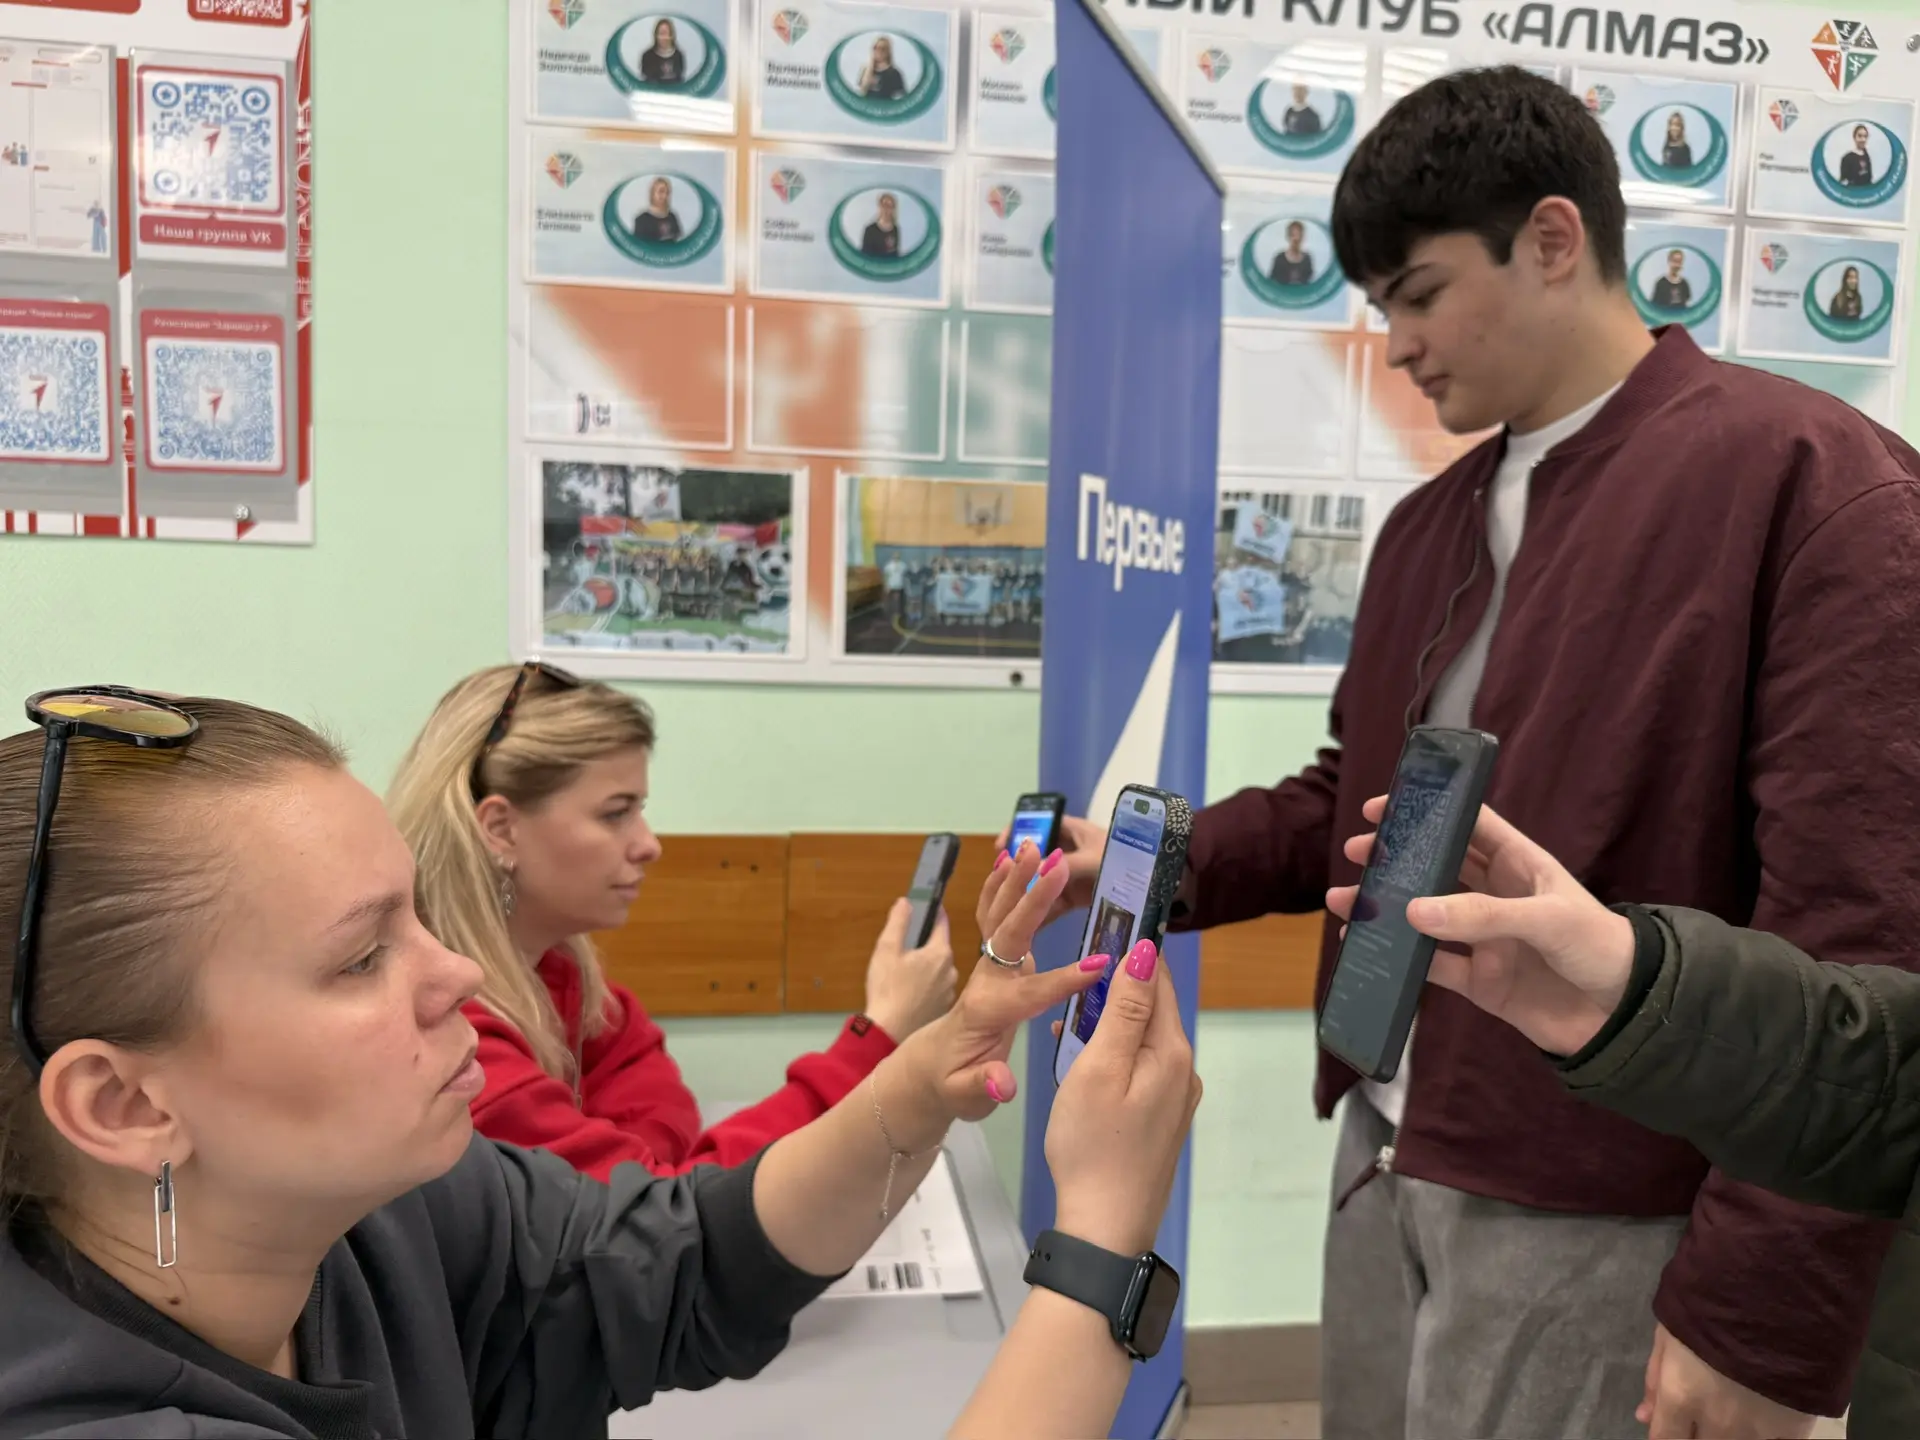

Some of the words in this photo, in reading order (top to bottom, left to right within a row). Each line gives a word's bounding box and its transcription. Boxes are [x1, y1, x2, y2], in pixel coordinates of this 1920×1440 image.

[1482, 2, 1770, 65] «АЛМАЗ»
[153, 223, 194, 239] Наша
[198, 227, 248, 243] группа
[249, 229, 272, 244] VK
[1077, 473, 1185, 592] Первые
